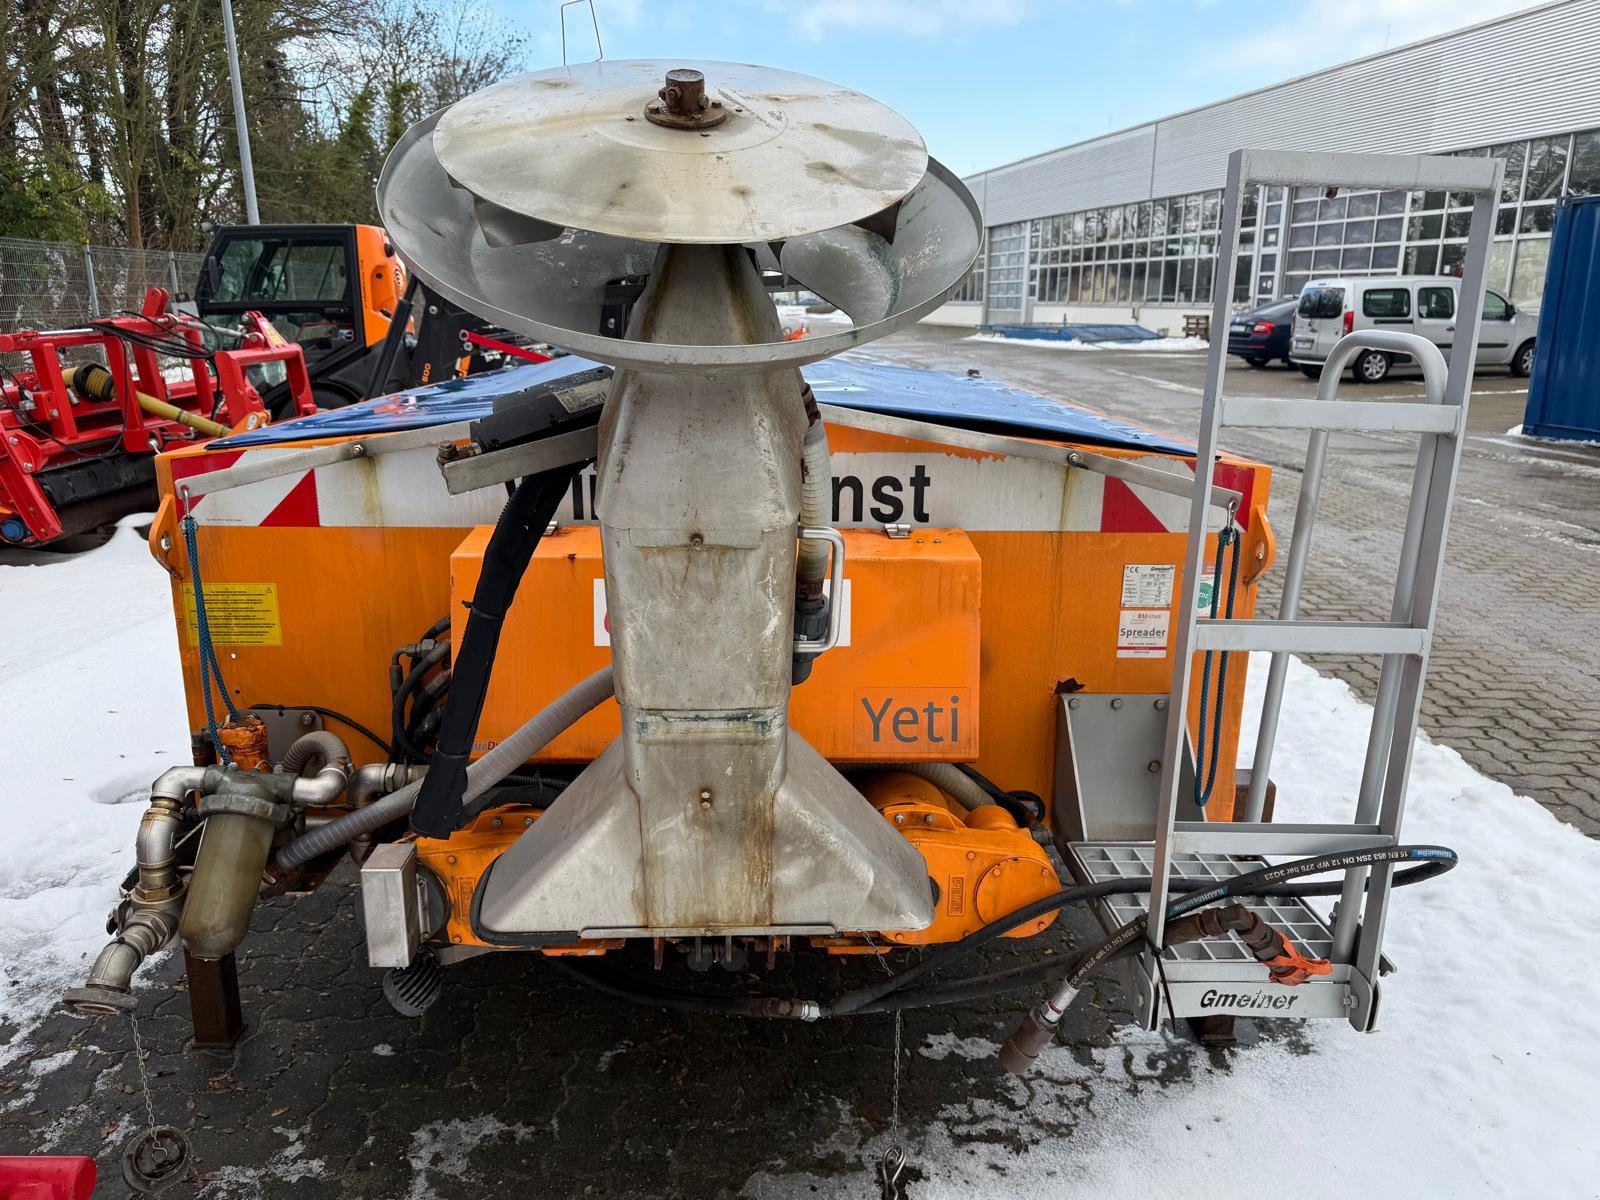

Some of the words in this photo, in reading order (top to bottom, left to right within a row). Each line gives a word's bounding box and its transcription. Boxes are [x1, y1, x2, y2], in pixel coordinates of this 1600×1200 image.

[1120, 627, 1166, 639] Spreader
[861, 695, 960, 743] Yeti
[1356, 854, 1372, 863] 2SN
[1388, 851, 1399, 860] EN
[1400, 850, 1408, 858] 15
[1316, 861, 1331, 869] WP
[1332, 858, 1341, 867] 12
[1343, 856, 1355, 865] DN
[1287, 866, 1300, 875] bar
[1301, 863, 1315, 871] 275
[1264, 870, 1286, 881] 3Q23
[1122, 928, 1136, 940] 2SN
[1111, 936, 1123, 947] DN
[1104, 943, 1113, 952] 12
[1095, 949, 1107, 960] WP
[1078, 967, 1088, 977] bar
[1200, 989, 1299, 1010] Gmeiner
